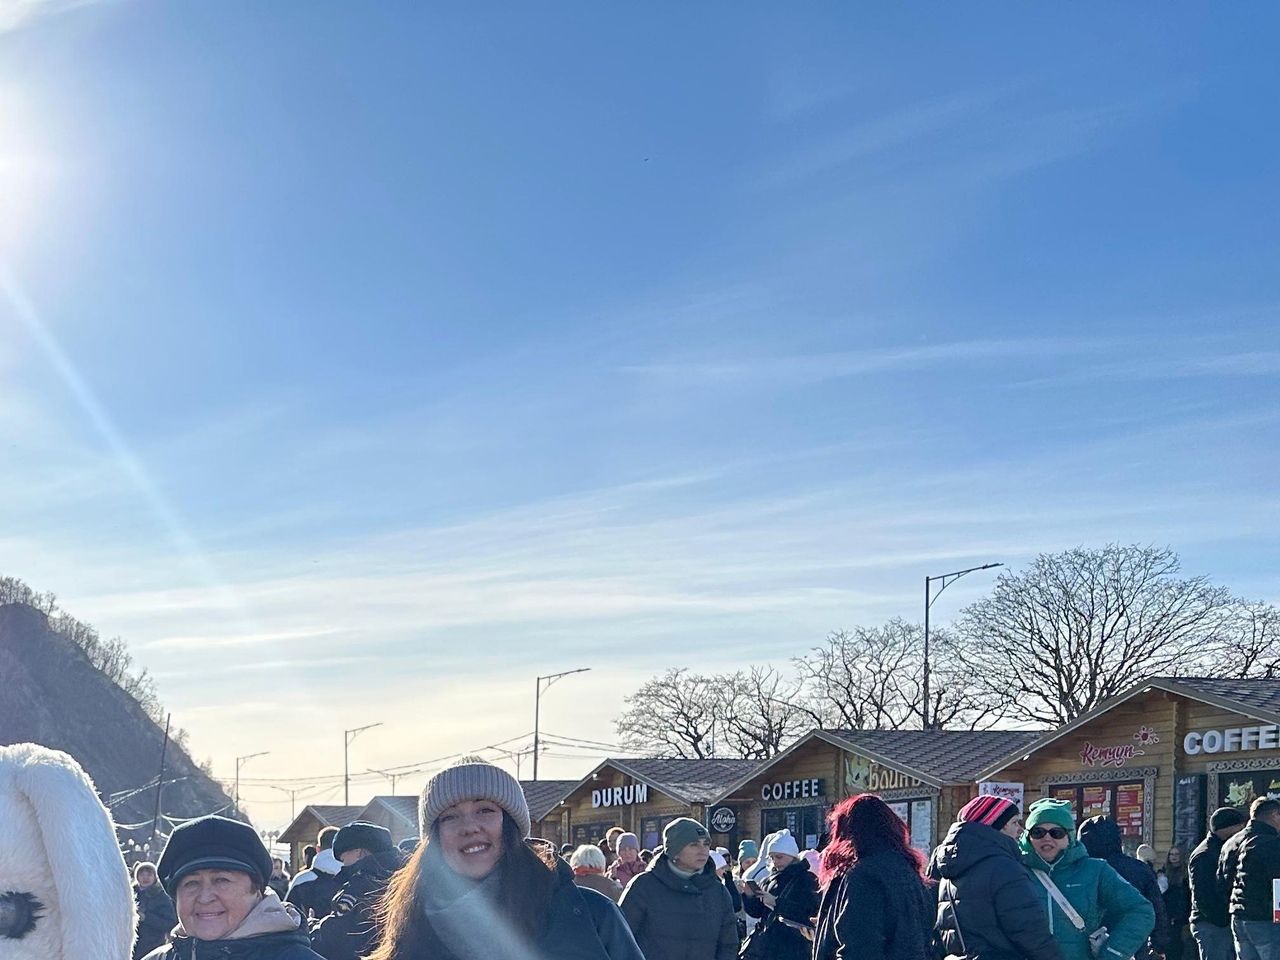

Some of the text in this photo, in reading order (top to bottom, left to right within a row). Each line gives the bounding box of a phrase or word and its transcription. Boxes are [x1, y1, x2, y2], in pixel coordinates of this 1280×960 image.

[1183, 725, 1280, 755] COFFE
[592, 783, 648, 808] DURUM
[761, 778, 819, 801] COFFEE
